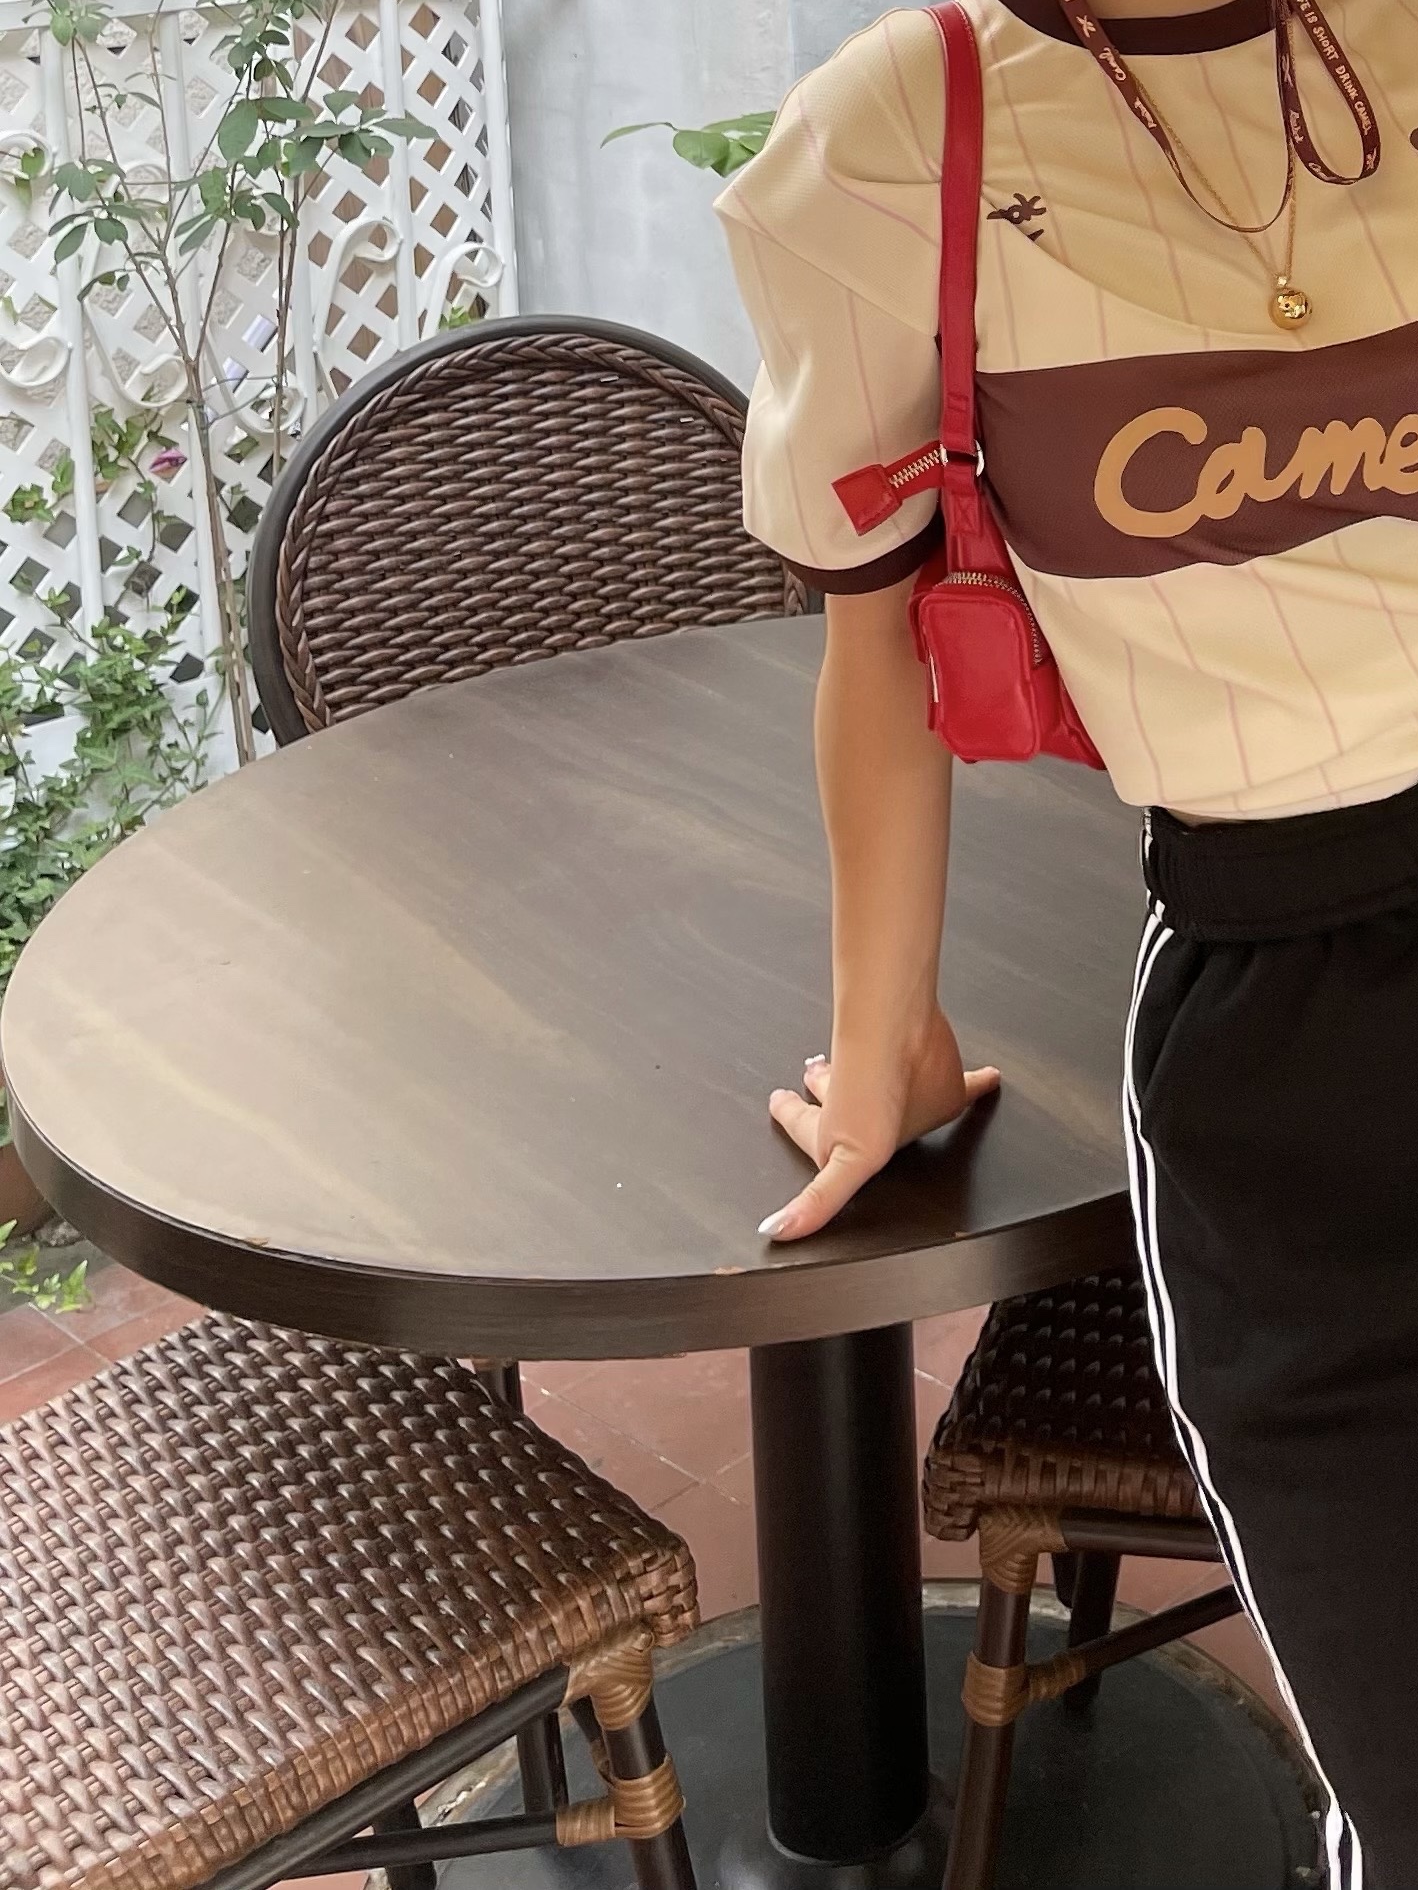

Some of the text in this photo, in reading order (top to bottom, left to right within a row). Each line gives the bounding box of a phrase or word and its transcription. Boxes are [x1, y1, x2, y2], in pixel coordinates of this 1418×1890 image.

[1304, 11, 1318, 24] IS
[1312, 26, 1340, 61] SHORT
[1335, 64, 1359, 101] DRINK
